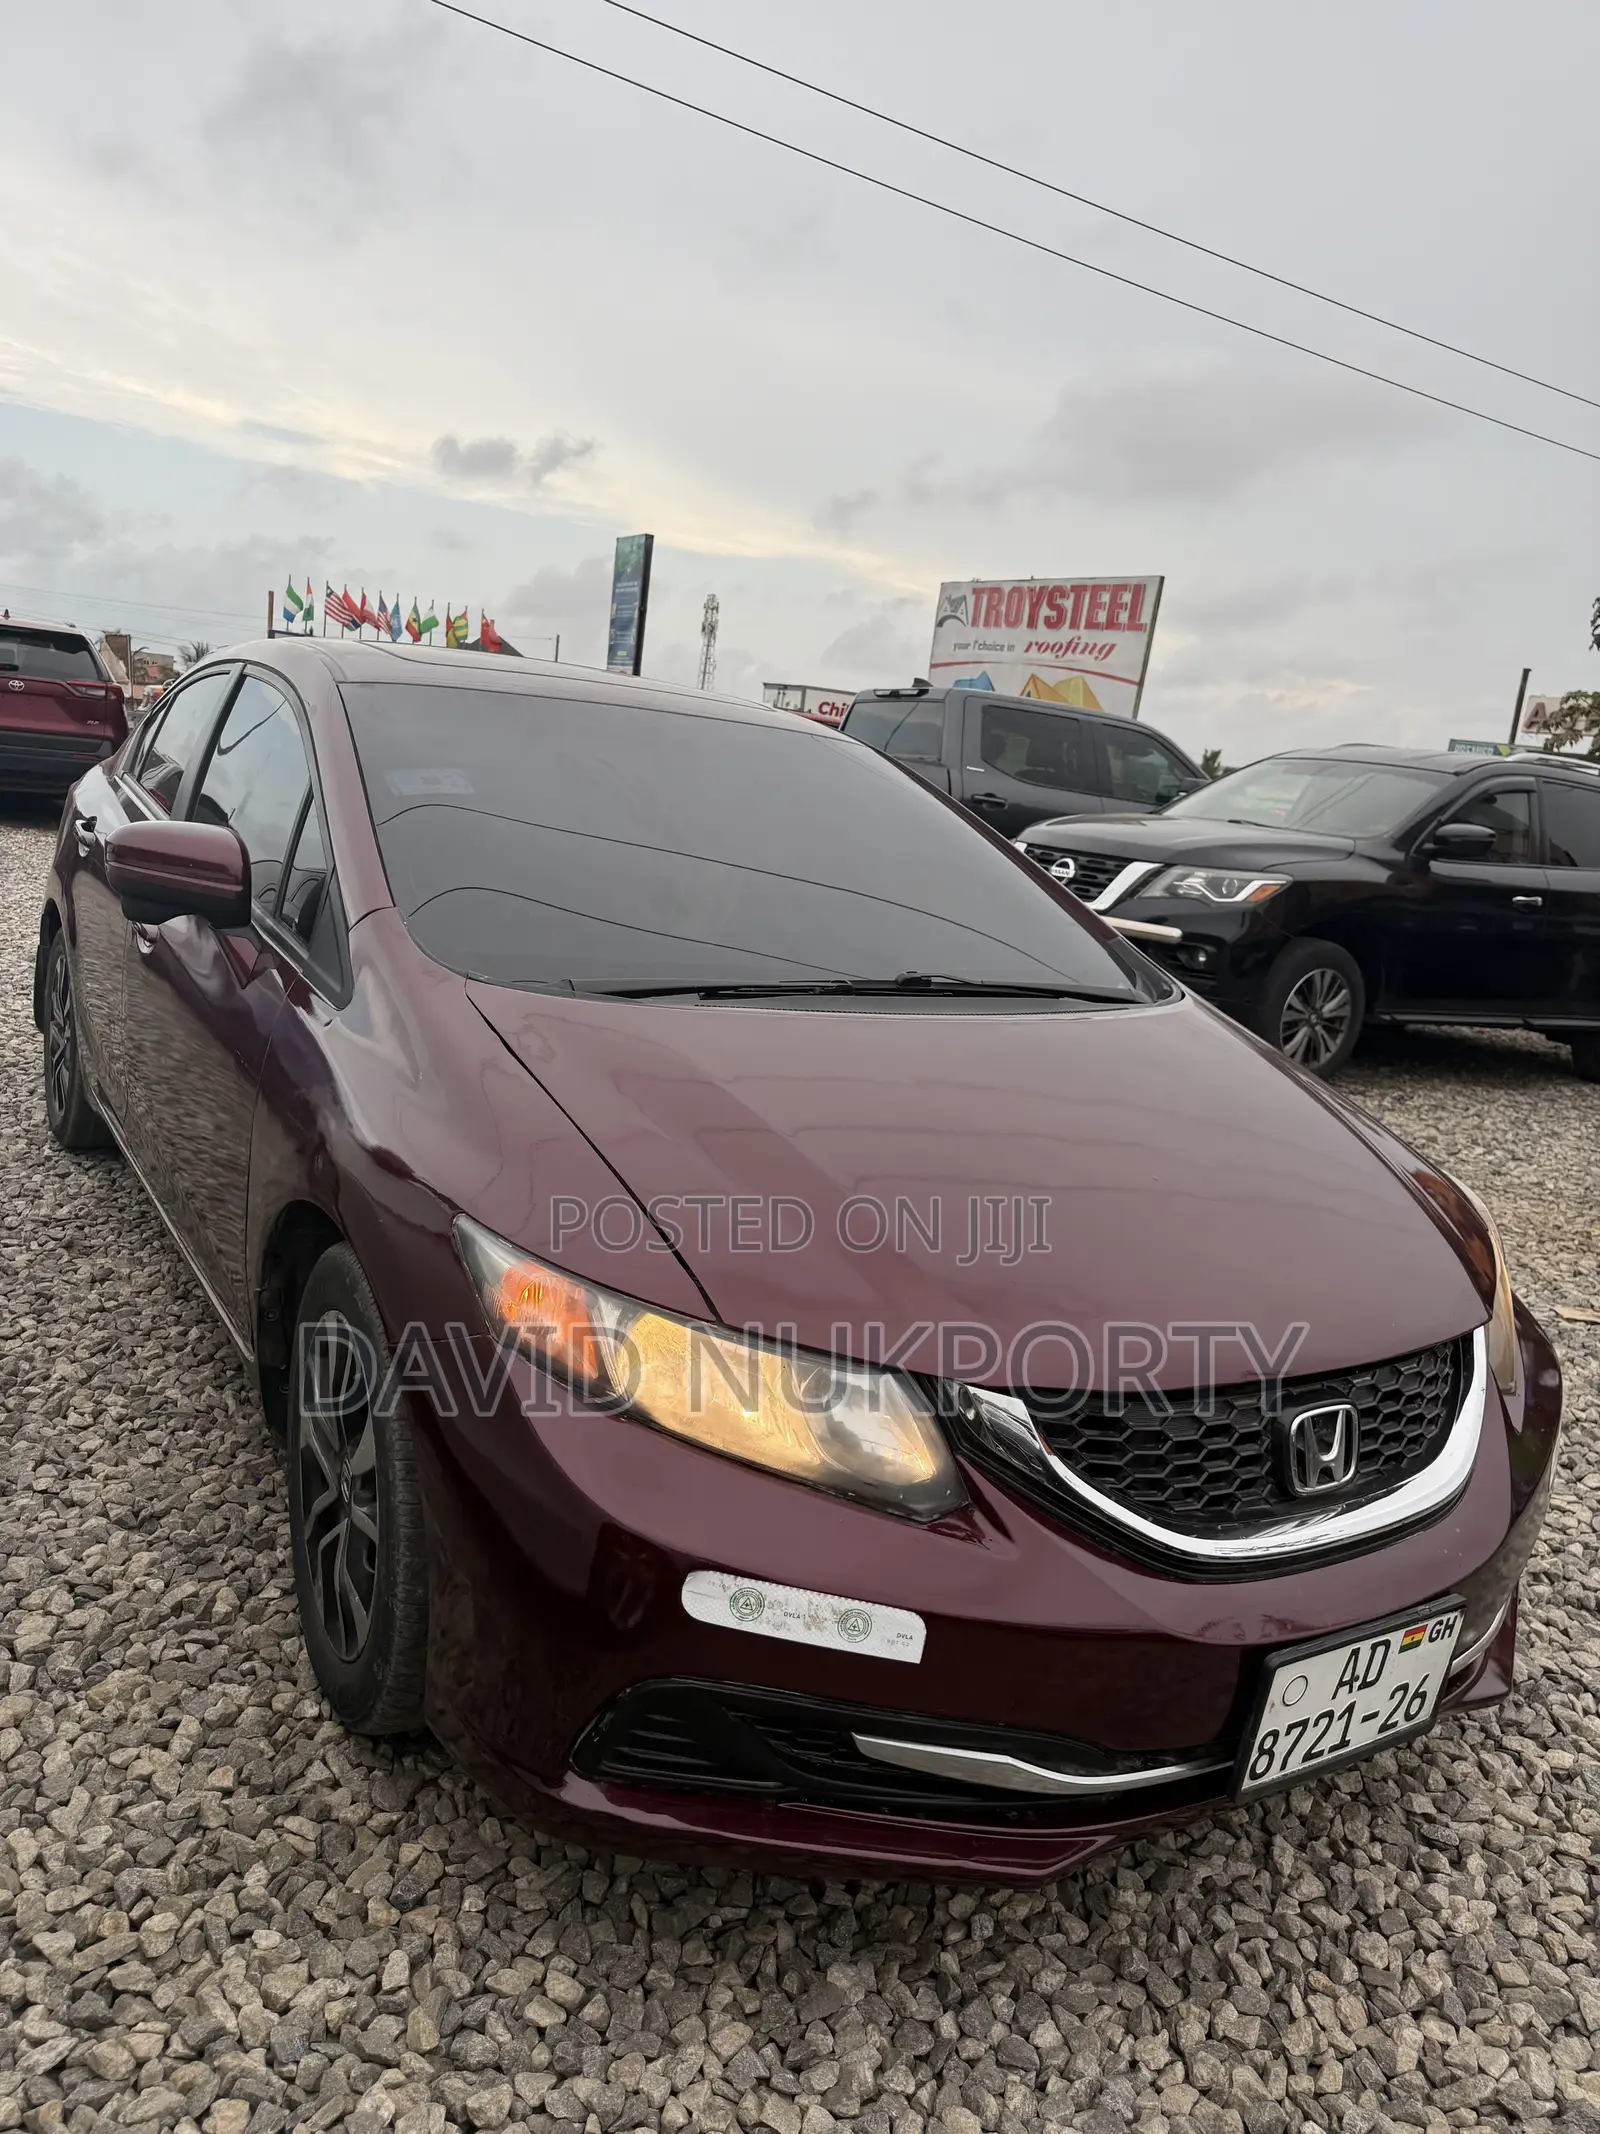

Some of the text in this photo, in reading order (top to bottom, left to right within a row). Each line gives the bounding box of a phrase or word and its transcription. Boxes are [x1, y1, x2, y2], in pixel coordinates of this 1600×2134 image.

[971, 583, 1148, 632] TROYSTEEL
[1023, 635, 1117, 661] roofing
[1428, 1615, 1459, 1643] GH
[1331, 1638, 1391, 1700] AD
[1249, 1673, 1430, 1781] 8721-26
